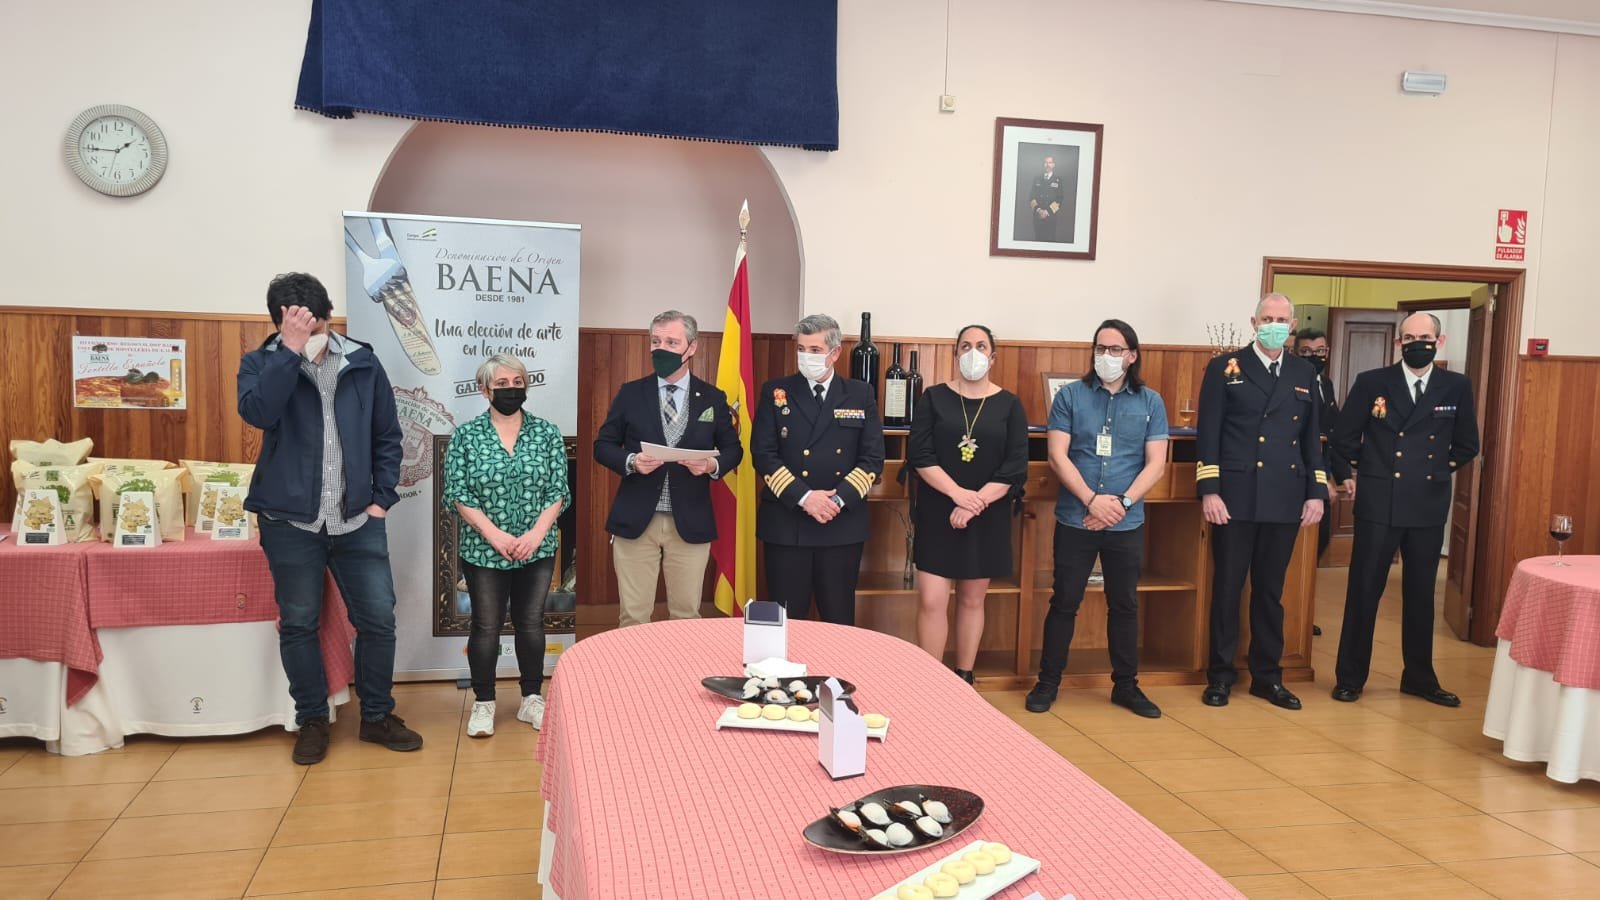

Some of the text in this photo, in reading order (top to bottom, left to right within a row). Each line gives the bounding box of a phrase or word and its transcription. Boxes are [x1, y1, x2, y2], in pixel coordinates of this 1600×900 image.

[100, 123, 108, 134] 11
[114, 121, 124, 132] 12
[90, 131, 100, 141] 10
[114, 171, 122, 181] 6
[511, 246, 526, 262] de
[528, 252, 564, 267] Origen
[437, 263, 562, 295] BAENA
[475, 294, 525, 304] DESDE 1981
[435, 318, 563, 341] Una elección de arte
[462, 344, 477, 356] en
[482, 339, 494, 357] la
[399, 406, 432, 427] AENA
